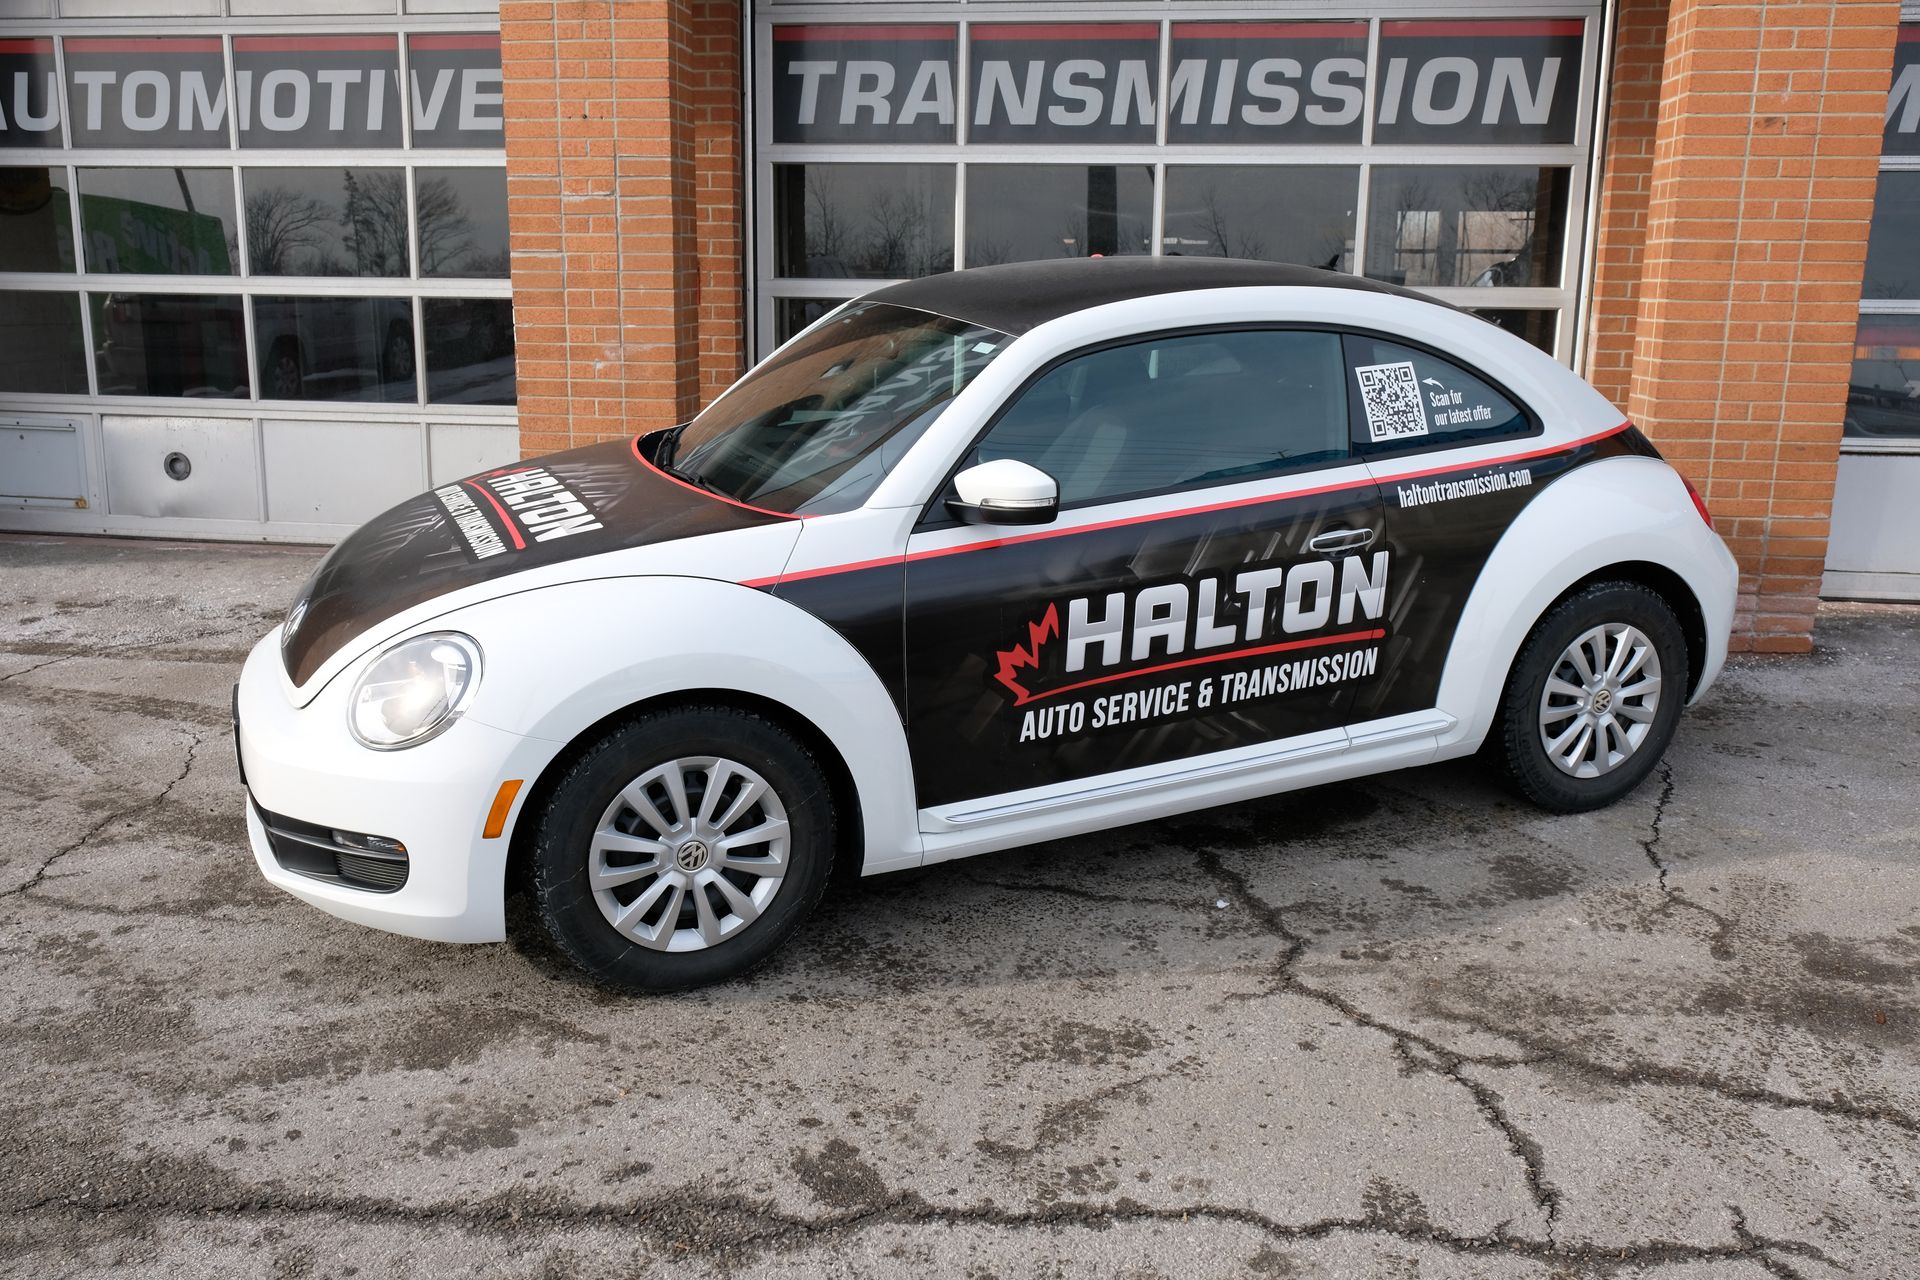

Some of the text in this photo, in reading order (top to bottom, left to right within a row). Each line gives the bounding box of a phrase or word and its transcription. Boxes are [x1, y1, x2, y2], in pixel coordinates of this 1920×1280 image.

[0, 70, 503, 131] UTOMOTIVE
[788, 57, 1562, 126] TRANSMISSION
[1429, 389, 1463, 408] Scan for
[1434, 405, 1492, 427] our latest offer
[487, 468, 604, 543] HALTON
[1397, 468, 1532, 508] haltontransmission.com
[1065, 550, 1390, 673] HALTON
[1019, 647, 1379, 742] AUTO SERVICE & TRANSMISSION
